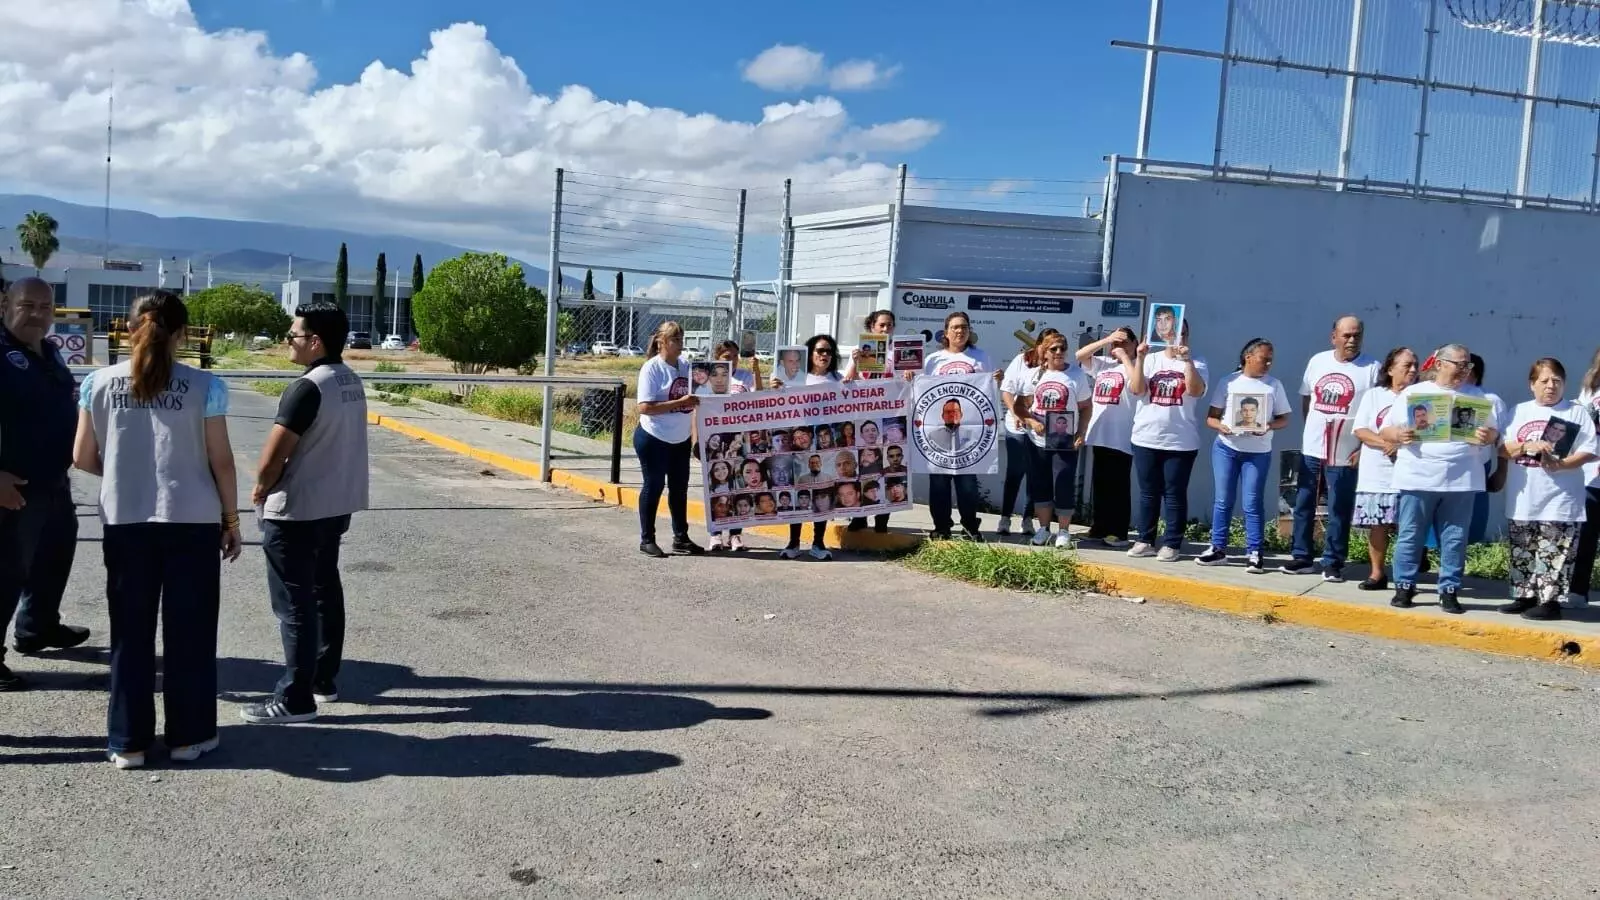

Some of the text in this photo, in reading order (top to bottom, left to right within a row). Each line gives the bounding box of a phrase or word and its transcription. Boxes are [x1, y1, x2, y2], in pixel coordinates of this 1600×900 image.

[903, 291, 955, 305] COAHUILA
[704, 399, 905, 426] DE BUSCAR HASTA NO ENCONTRARLES
[724, 387, 885, 412] PROHIBIDO OLVIDAR Y DEJAR
[917, 386, 991, 416] HASTA ENCONTRARTE
